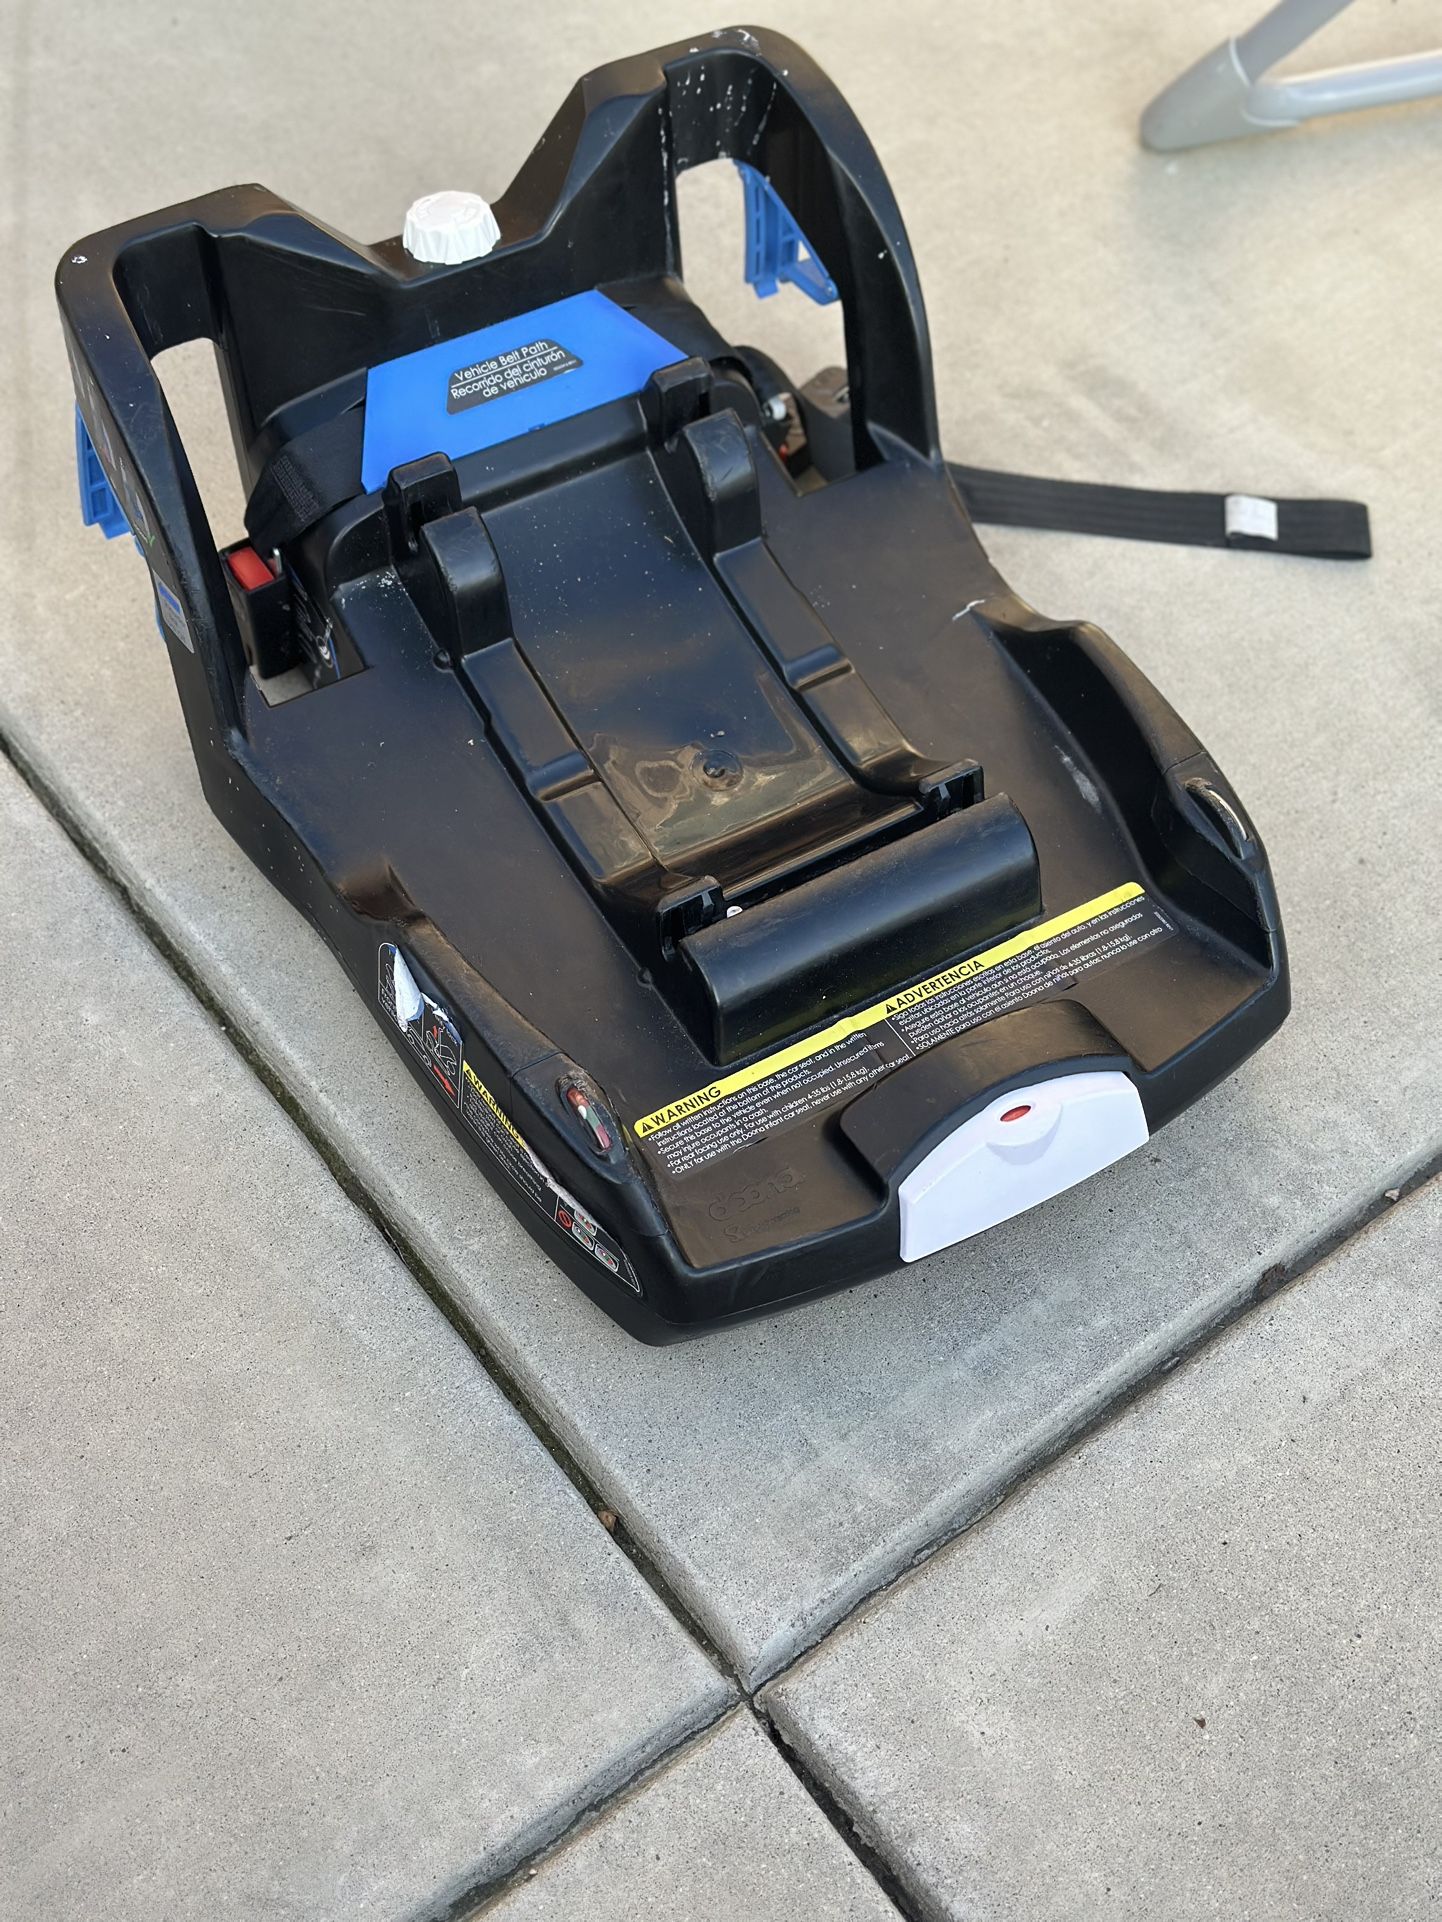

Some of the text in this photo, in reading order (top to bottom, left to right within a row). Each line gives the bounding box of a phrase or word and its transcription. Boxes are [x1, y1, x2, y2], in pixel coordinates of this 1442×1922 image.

[451, 373, 503, 399] Recorrido
[503, 365, 522, 379] del
[519, 350, 565, 371] cinturón
[454, 341, 548, 381] Vehicle Belt Path
[482, 386, 498, 397] de
[896, 960, 984, 1008] ADVERTENCIA
[904, 1016, 930, 1031] Asegure
[929, 1009, 944, 1019] esta
[942, 1002, 959, 1012] base
[1058, 947, 1070, 955] Los
[1069, 933, 1100, 950] elementos
[1108, 912, 1143, 931] asegurados
[907, 1002, 926, 1013] todas
[934, 979, 973, 1000] instrucciones
[1003, 957, 1017, 966] esta
[1039, 936, 1061, 948] asiento
[1060, 931, 1071, 939] del
[1107, 895, 1144, 916] instrucciones
[908, 1022, 934, 1038] pueden
[966, 990, 1000, 1008] ocupantes
[913, 1033, 929, 1043] Para
[928, 1027, 940, 1035] uso
[939, 1018, 959, 1030] hacia
[1004, 988, 1020, 998] Para
[1019, 983, 1031, 991] uso
[1031, 976, 1044, 985] con
[1068, 957, 1081, 966] 4-35
[1079, 951, 1096, 961] libras
[918, 1027, 955, 1049] SOLAMENTE
[954, 1021, 971, 1032] para
[969, 1015, 982, 1024] uso
[981, 1009, 995, 1018] con
[1000, 995, 1023, 1009] asiento
[1021, 985, 1044, 998] Doona
[1043, 980, 1053, 988] de
[1068, 965, 1083, 976] para
[1100, 947, 1121, 960] nunca
[1126, 939, 1138, 947] use
[1137, 933, 1150, 942] con
[1149, 927, 1163, 936] otro
[921, 997, 950, 1014] ubicadas
[965, 982, 983, 993] parte
[981, 972, 1002, 984] inferior
[474, 1075, 519, 1138] WARNING
[650, 1127, 672, 1140] Follow
[672, 1122, 681, 1130] all
[680, 1112, 703, 1126] written
[701, 1095, 737, 1116] instructions
[737, 1091, 747, 1099] on
[746, 1085, 758, 1094] this
[775, 1071, 787, 1080] the
[787, 1065, 799, 1074] car
[814, 1050, 829, 1061] and
[834, 1042, 846, 1051] the
[845, 1032, 867, 1044] written
[650, 1086, 721, 1126] WARNING
[656, 1126, 692, 1146] instructions
[691, 1113, 719, 1129] located
[718, 1109, 726, 1117] at
[725, 1104, 738, 1112] the
[737, 1092, 763, 1107] bottom
[762, 1087, 770, 1095] of
[769, 1083, 781, 1091] the
[659, 1139, 684, 1154] Secure
[683, 1133, 696, 1142] this
[694, 1126, 712, 1137] base
[719, 1116, 732, 1124] the
[731, 1105, 755, 1118] vehicle
[755, 1096, 773, 1107] even
[772, 1087, 791, 1099] when
[790, 1080, 802, 1090] not
[834, 1046, 869, 1068] Unsecured
[666, 1149, 682, 1159] may
[681, 1140, 700, 1152] injure
[700, 1123, 736, 1143] occupants
[742, 1116, 748, 1124] a
[669, 1158, 681, 1167] For
[681, 1151, 695, 1161] rear
[694, 1141, 718, 1155] facing
[716, 1135, 729, 1144] use
[743, 1121, 755, 1129] For
[754, 1116, 767, 1125] use
[766, 1109, 782, 1119] with
[781, 1097, 807, 1112] children
[807, 1089, 821, 1099] 4-35
[674, 1160, 694, 1173] ONLY
[693, 1156, 704, 1164] for
[703, 1150, 716, 1159] use
[715, 1143, 731, 1153] with
[729, 1137, 742, 1146] the
[741, 1126, 765, 1140] Doona
[763, 1116, 784, 1129] infant
[783, 1110, 795, 1120] car
[811, 1093, 830, 1106] never
[829, 1088, 842, 1097] use
[841, 1081, 856, 1091] with
[855, 1075, 868, 1084] any
[866, 1064, 885, 1078] other
